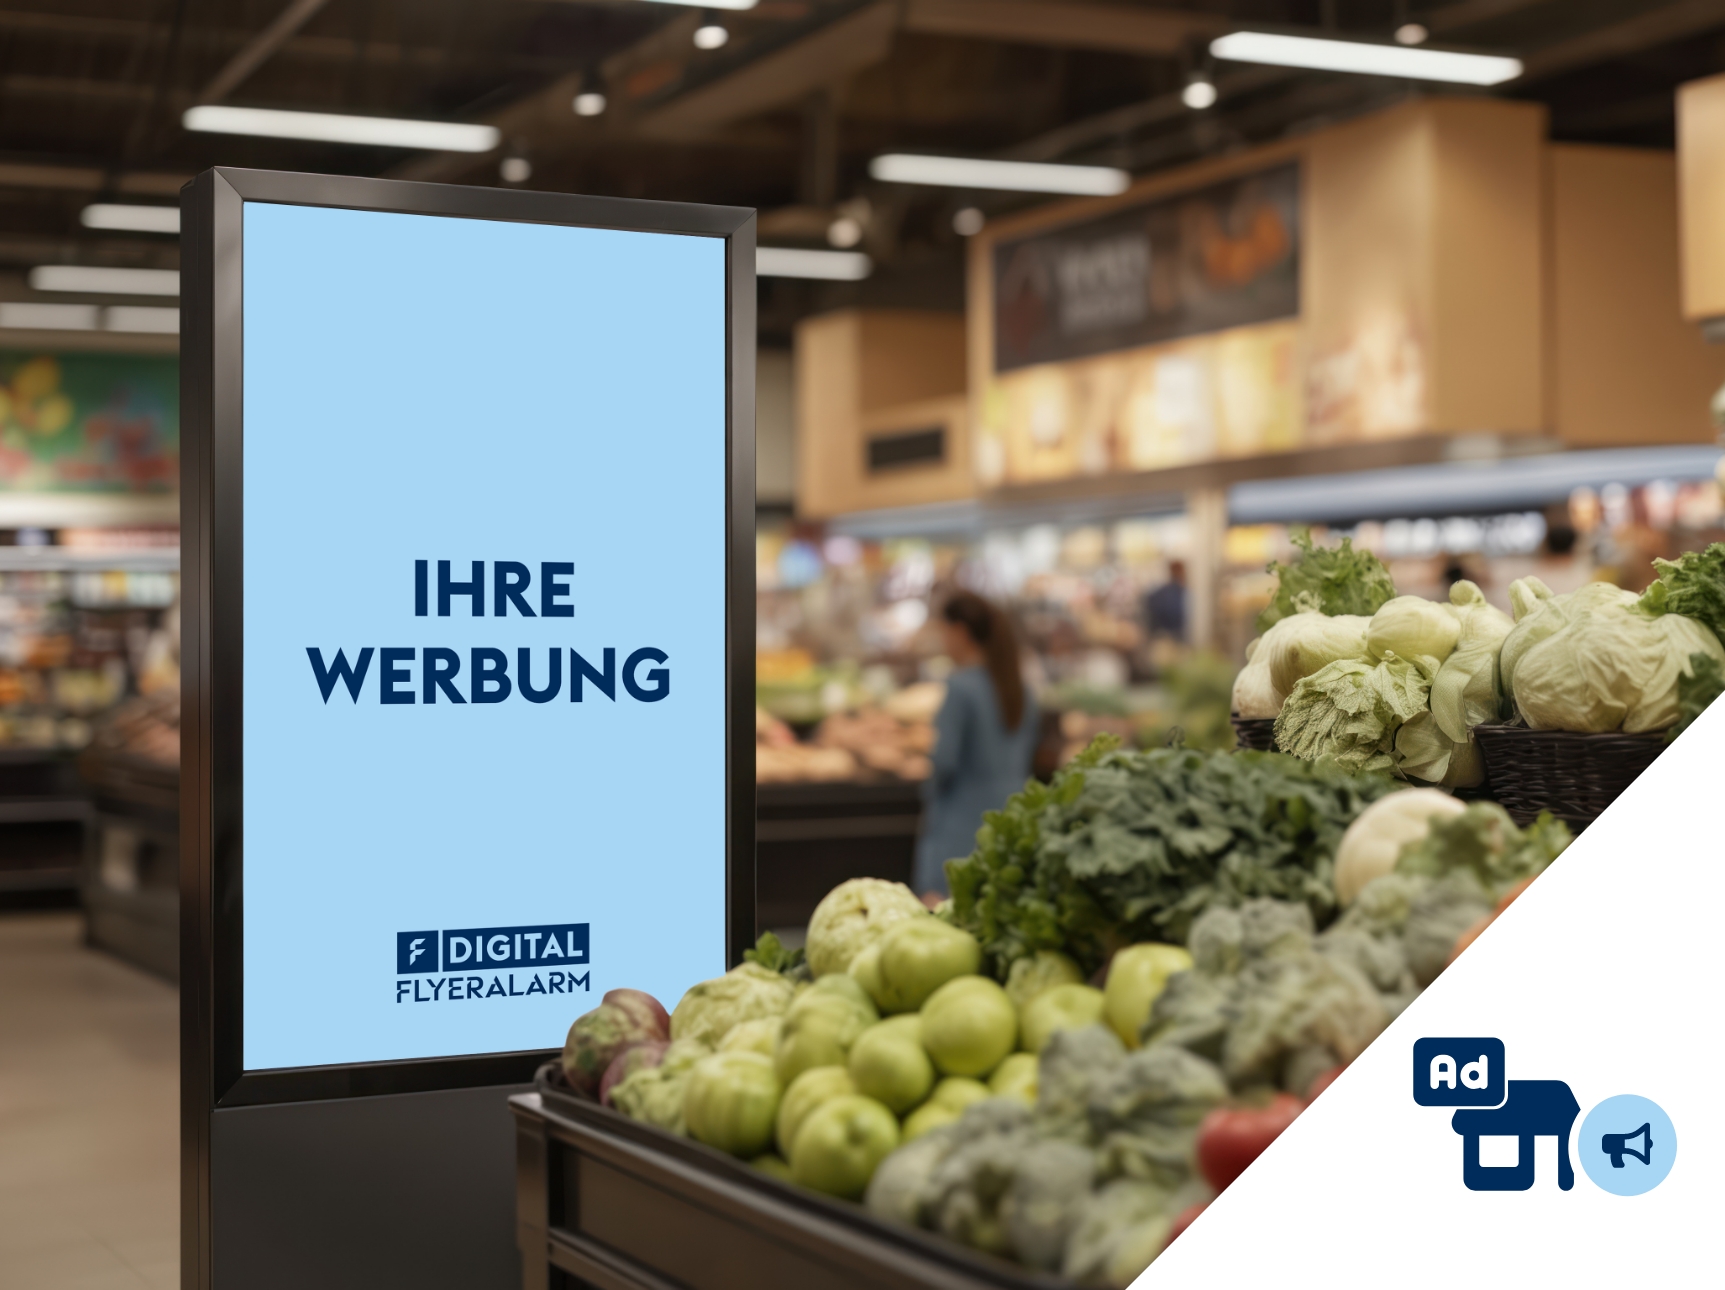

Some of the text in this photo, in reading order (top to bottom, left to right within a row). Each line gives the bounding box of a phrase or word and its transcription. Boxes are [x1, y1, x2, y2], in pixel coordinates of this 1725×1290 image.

[414, 559, 575, 618] IHRE
[305, 646, 670, 705] WERBUNG
[449, 931, 584, 964] DIGITAL
[396, 970, 590, 1003] FLYERALARM
